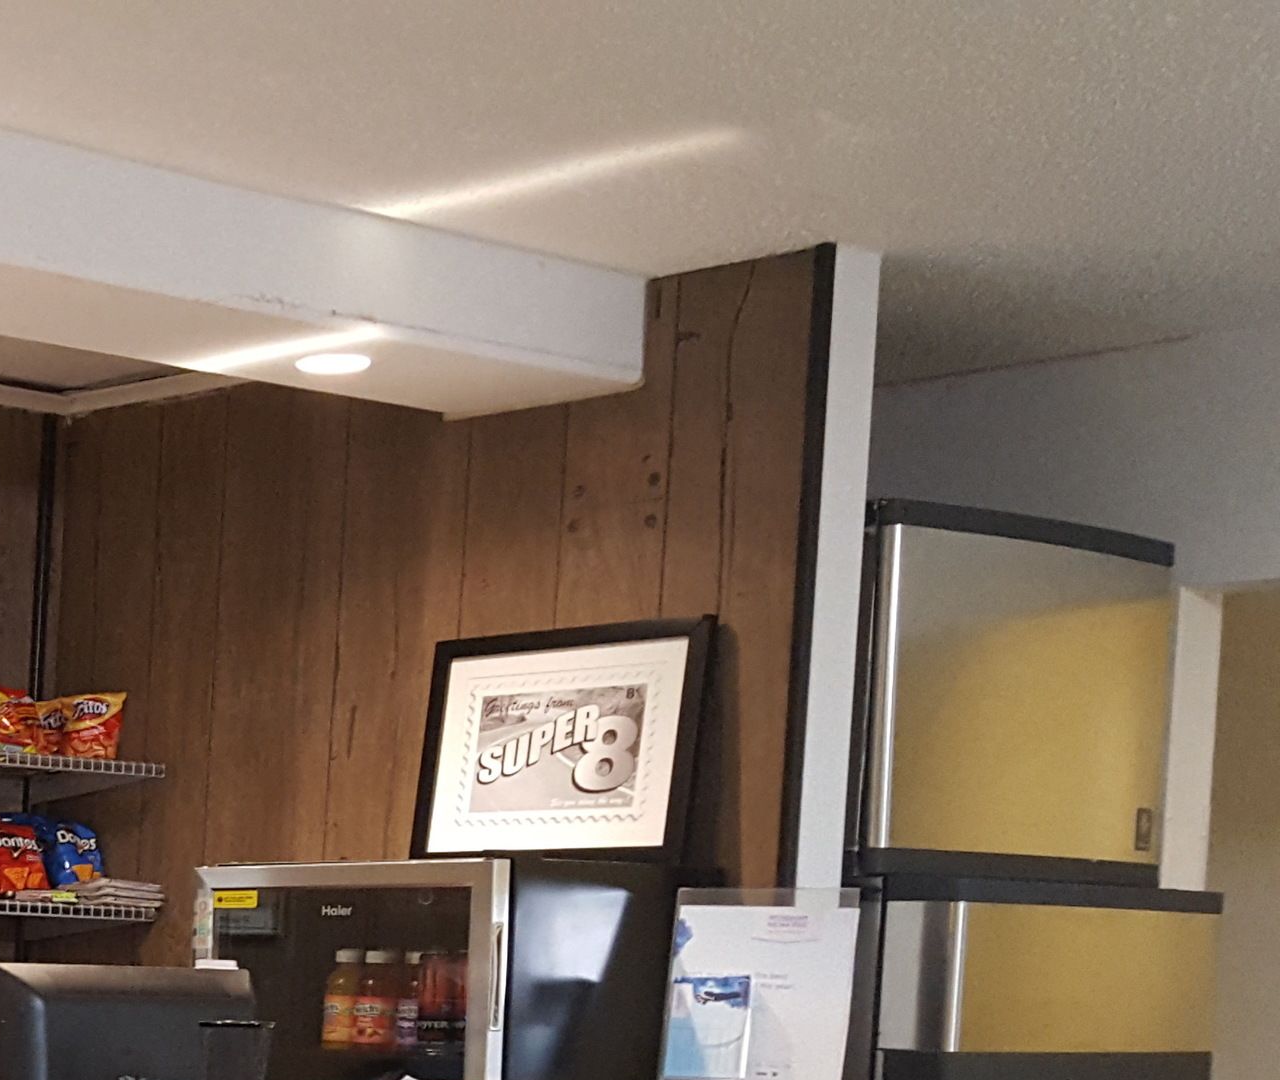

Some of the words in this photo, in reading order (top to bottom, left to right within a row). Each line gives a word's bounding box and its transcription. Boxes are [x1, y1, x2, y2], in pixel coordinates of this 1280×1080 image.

[476, 703, 601, 785] SUPER
[571, 714, 639, 794] 8
[321, 905, 353, 916] Haier
